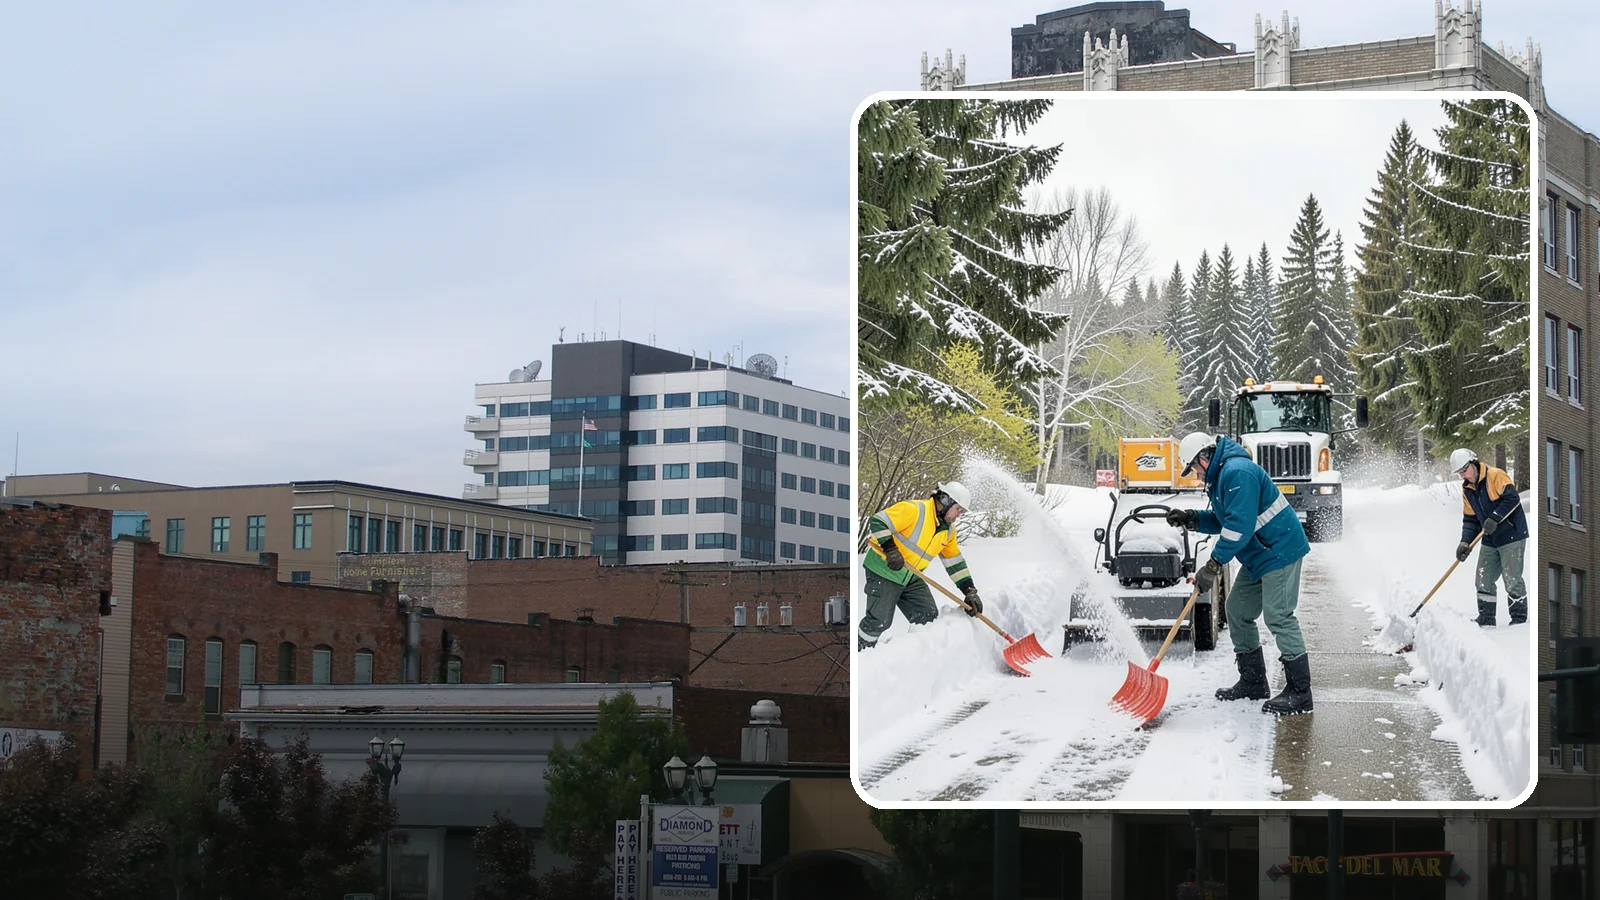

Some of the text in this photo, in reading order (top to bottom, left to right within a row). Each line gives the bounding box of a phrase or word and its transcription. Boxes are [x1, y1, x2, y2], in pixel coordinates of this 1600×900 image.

[371, 566, 427, 576] Furnishers
[660, 818, 713, 832] DIAMOND
[1022, 815, 1070, 828] BUILDING
[656, 845, 716, 854] RESERVED PARKING
[616, 825, 625, 893] PAY HERE
[628, 824, 636, 893] PAY HERE
[721, 851, 739, 861] Soup
[671, 862, 701, 870] PATRONS
[1346, 856, 1385, 875] DEL
[1392, 857, 1443, 877] MAR
[660, 889, 710, 898] PUBLIC PARKING
